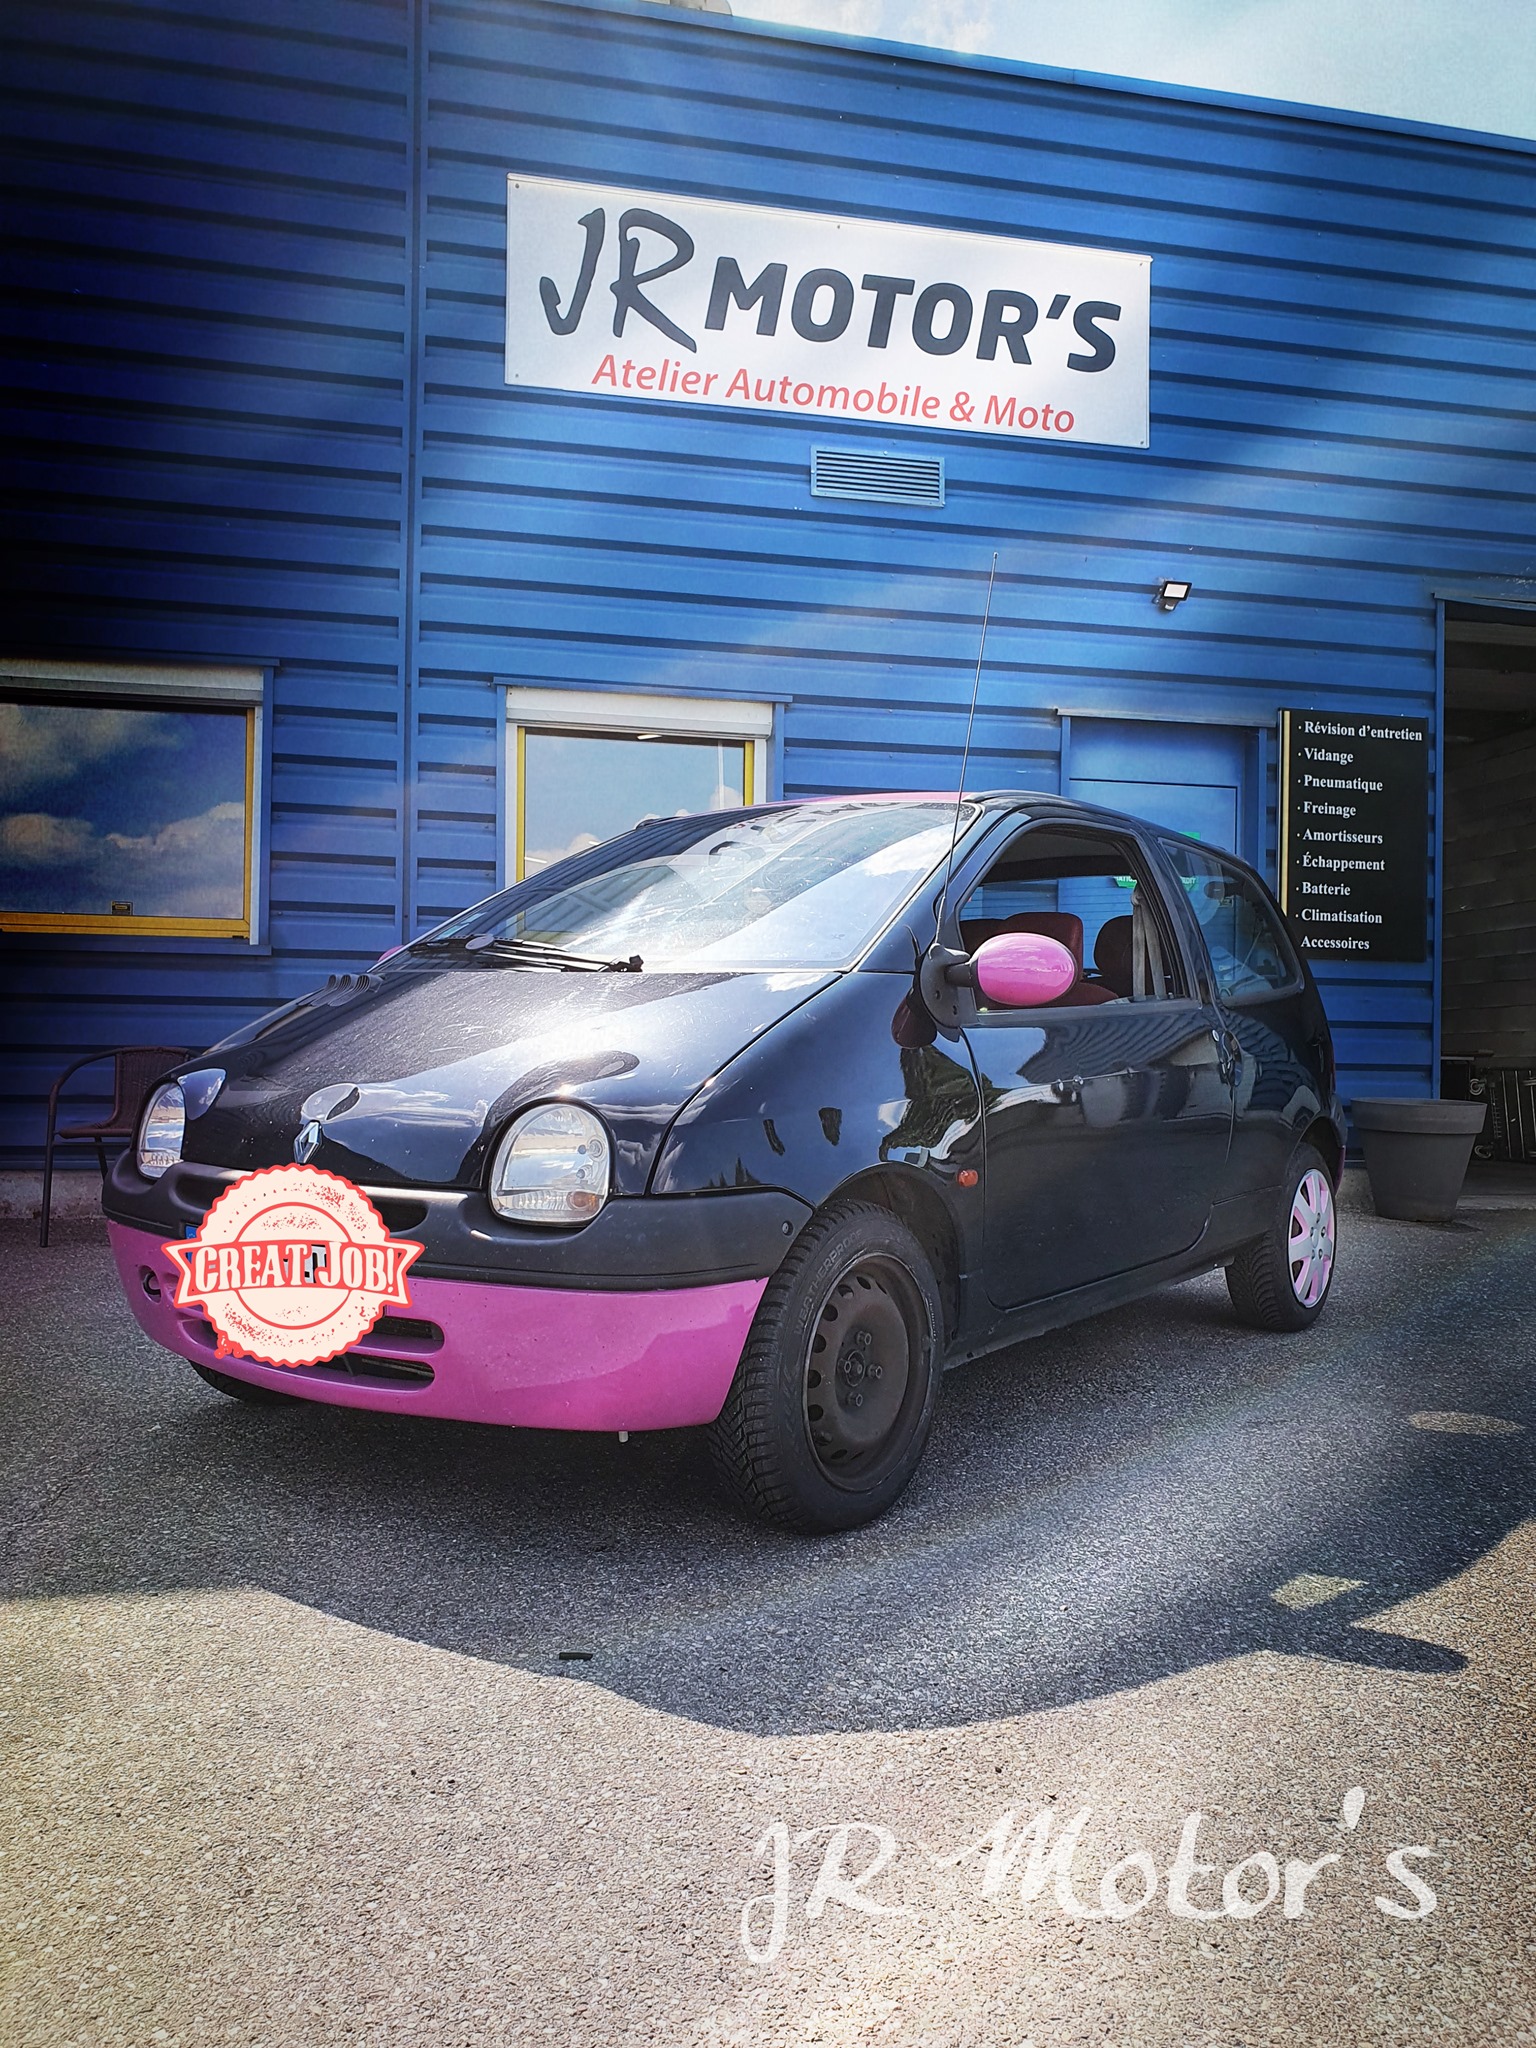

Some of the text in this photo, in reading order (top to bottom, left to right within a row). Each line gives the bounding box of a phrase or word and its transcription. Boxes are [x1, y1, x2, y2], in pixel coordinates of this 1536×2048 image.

[540, 208, 1121, 373] JR MOTOR'S
[591, 354, 1075, 433] Atelier Automobile & Moto
[1304, 720, 1423, 742] Révision d'entretien
[1303, 747, 1354, 766] Vidange
[1304, 774, 1384, 794] Pneumatique
[1303, 801, 1357, 819] Freinage
[1302, 828, 1384, 845] Amortisseurs
[1302, 851, 1386, 872] Échappement
[1302, 881, 1351, 897] Batterie
[1301, 908, 1384, 925] Climatisation
[1301, 935, 1370, 951] Accessoires
